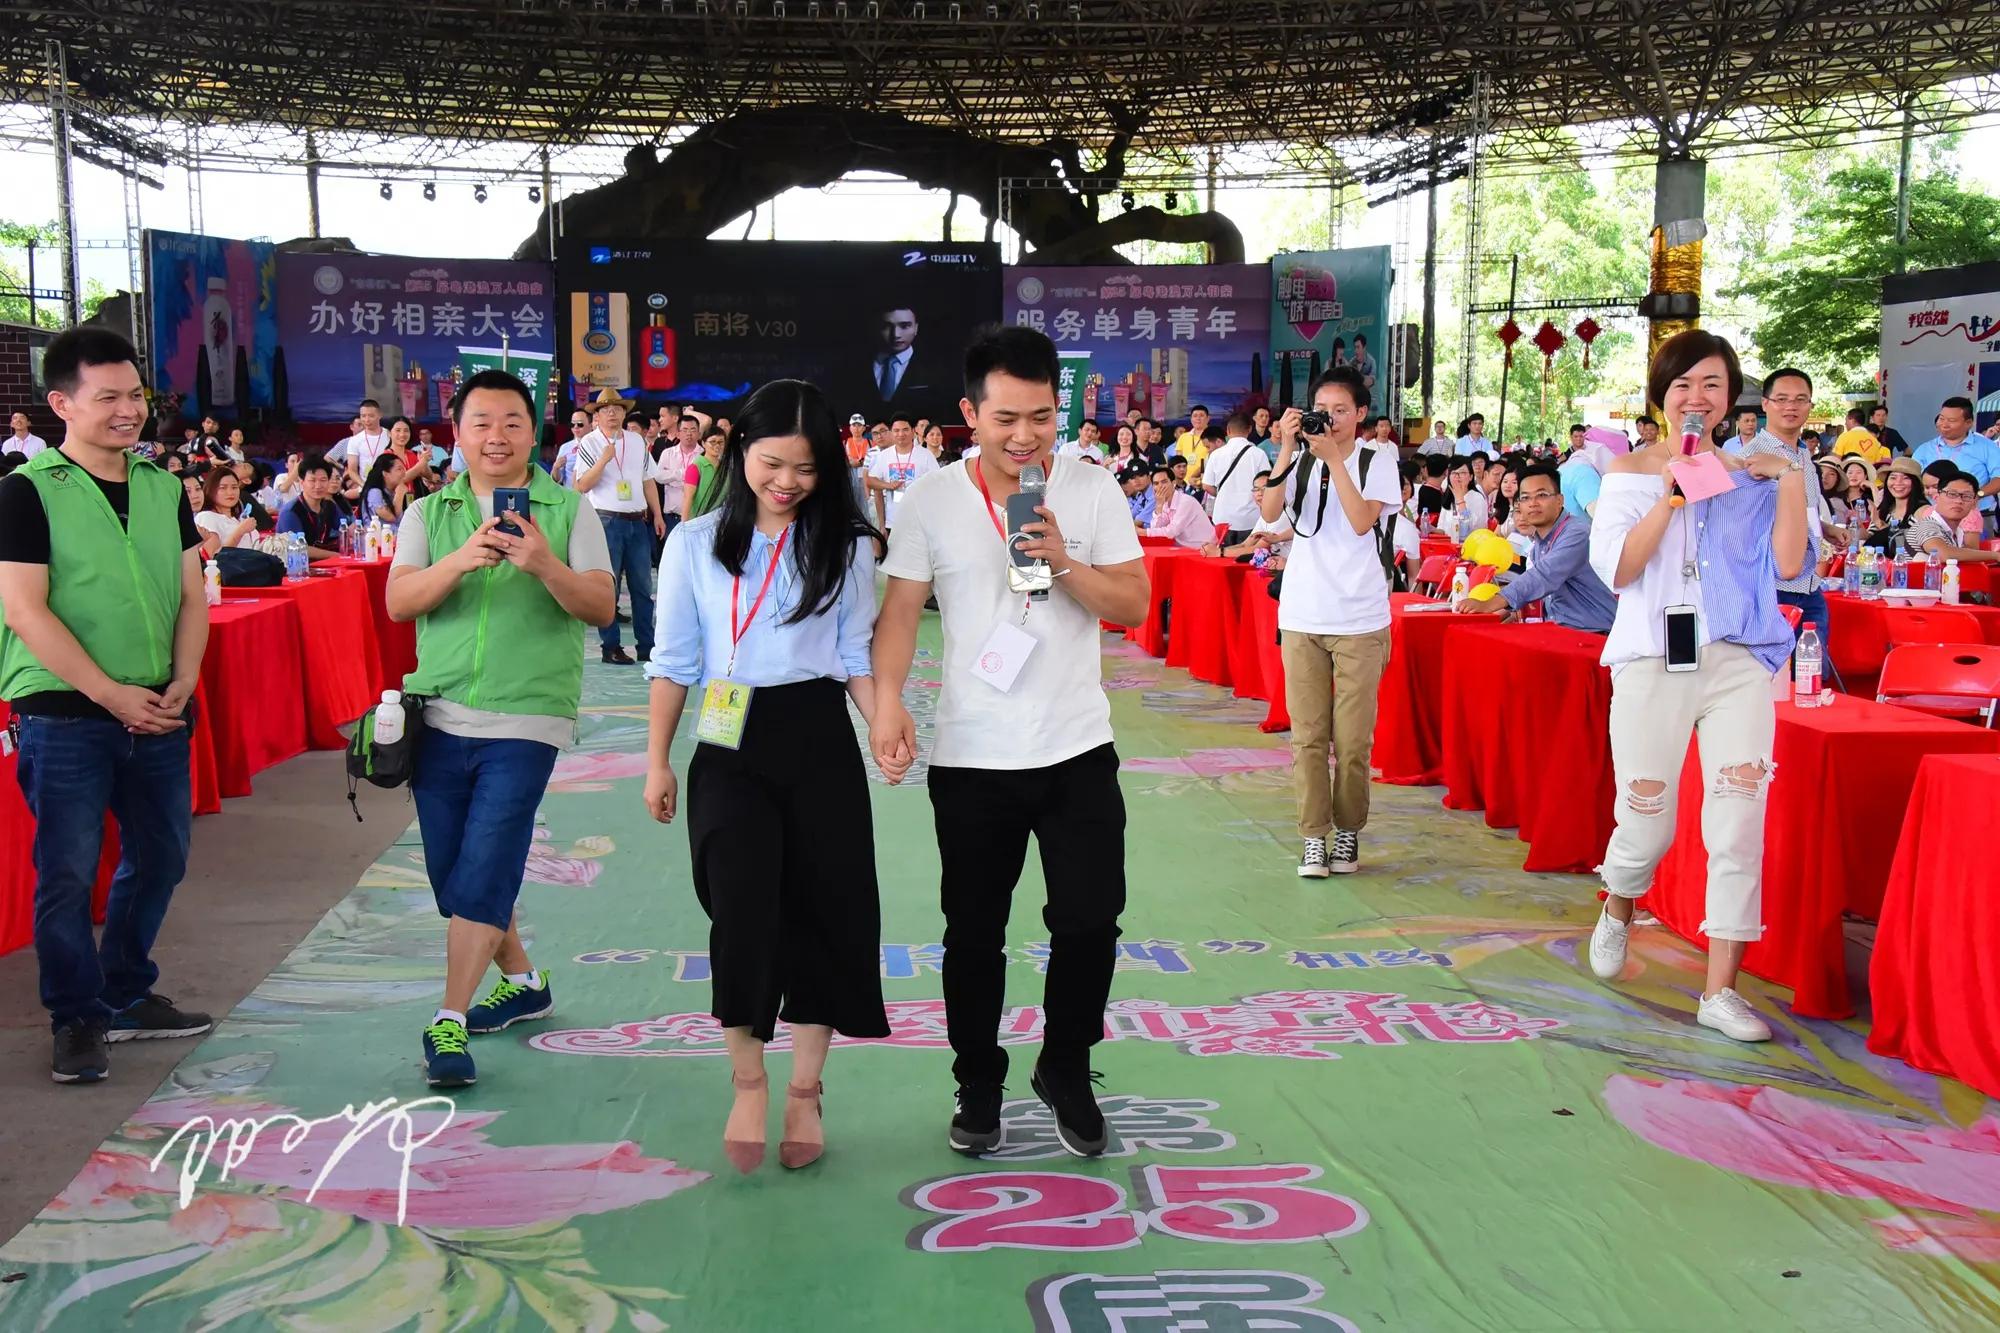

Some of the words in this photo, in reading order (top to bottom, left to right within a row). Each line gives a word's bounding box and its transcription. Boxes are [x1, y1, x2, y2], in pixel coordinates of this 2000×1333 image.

[308, 299, 544, 338] 办好相亲大会
[692, 312, 750, 337] 南将
[754, 320, 797, 338] V30
[1016, 306, 1238, 342] 服务单身青年
[1287, 948, 1453, 970] 相约
[908, 1162, 1370, 1254] 25
